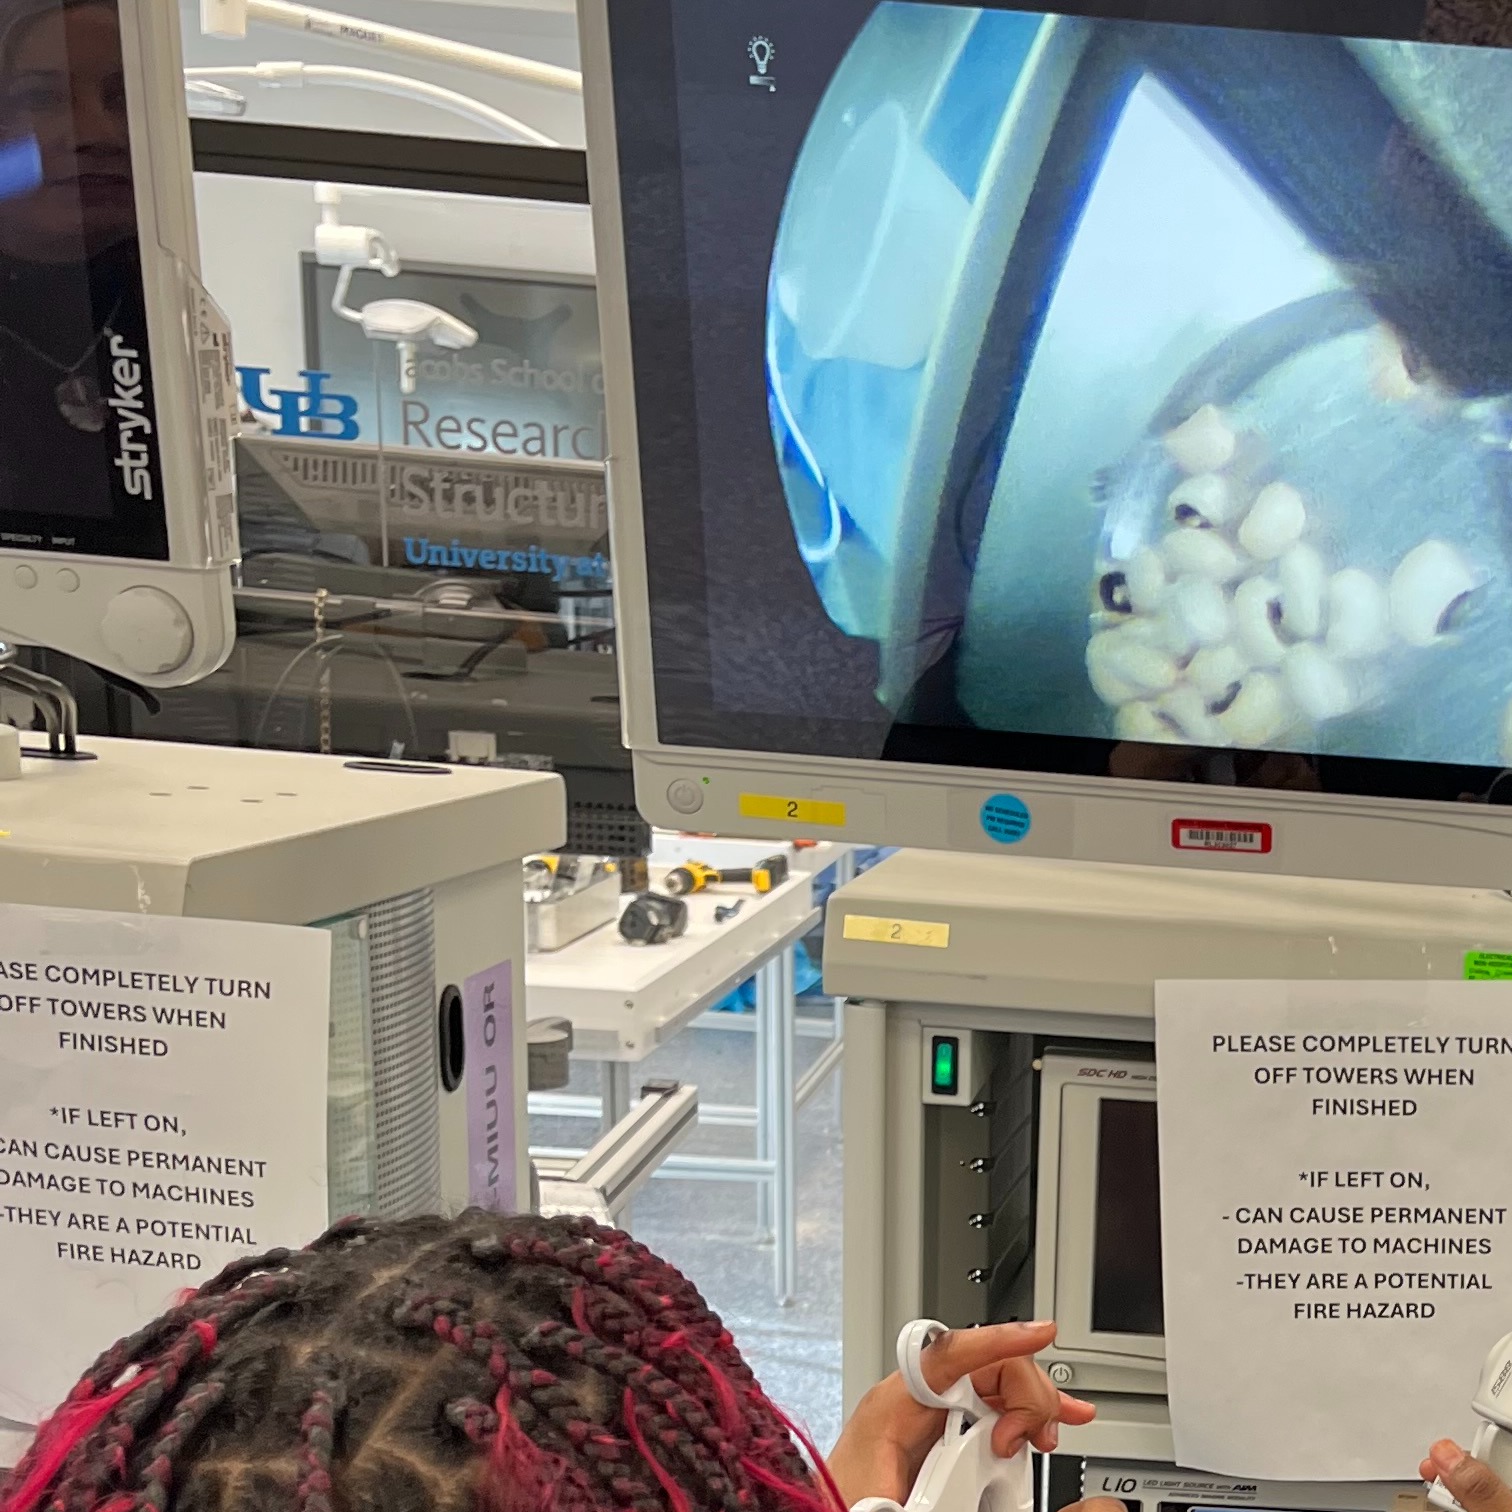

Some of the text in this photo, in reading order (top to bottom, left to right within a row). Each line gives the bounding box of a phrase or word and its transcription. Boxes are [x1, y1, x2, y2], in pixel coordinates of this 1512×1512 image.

[107, 334, 153, 500] stryker
[403, 536, 570, 582] University
[787, 801, 798, 818] 2
[891, 923, 902, 940] 2
[44, 964, 199, 994] COMPLETELY
[204, 977, 271, 1000] TURN
[46, 997, 147, 1023] TOWERS
[151, 1006, 226, 1029] WHEN
[483, 982, 497, 1047] OR
[59, 1031, 168, 1057] FINISHED
[1212, 1035, 1296, 1053] PLEASE
[1302, 1035, 1450, 1054] COMPLETELY
[1108, 1069, 1128, 1079] HD
[1254, 1066, 1474, 1086] OFF TOWERS WHEN
[1312, 1098, 1418, 1117] FINISHED
[87, 1109, 138, 1130] LEFT
[143, 1114, 186, 1137] ON,
[44, 1142, 121, 1166] CAUSE
[127, 1149, 267, 1178] PERMANENT
[1335, 1171, 1385, 1188] LEFT
[1389, 1171, 1430, 1191] ON,
[95, 1178, 126, 1197] TO
[132, 1181, 255, 1208] MACHINES
[1235, 1207, 1283, 1224] CAN
[1289, 1206, 1364, 1224] CAUSE
[1370, 1207, 1507, 1225] PERMANENT
[67, 1212, 110, 1232] ARE
[115, 1217, 130, 1234] A
[135, 1218, 258, 1246] POTENTIAL
[57, 1241, 201, 1270] FIRE HAZARD
[1237, 1237, 1492, 1255] DAMAGE TO MACHINES
[1236, 1272, 1493, 1290] -THEY ARE A POTENTIAL
[1294, 1302, 1436, 1319] FIRE HAZARD
